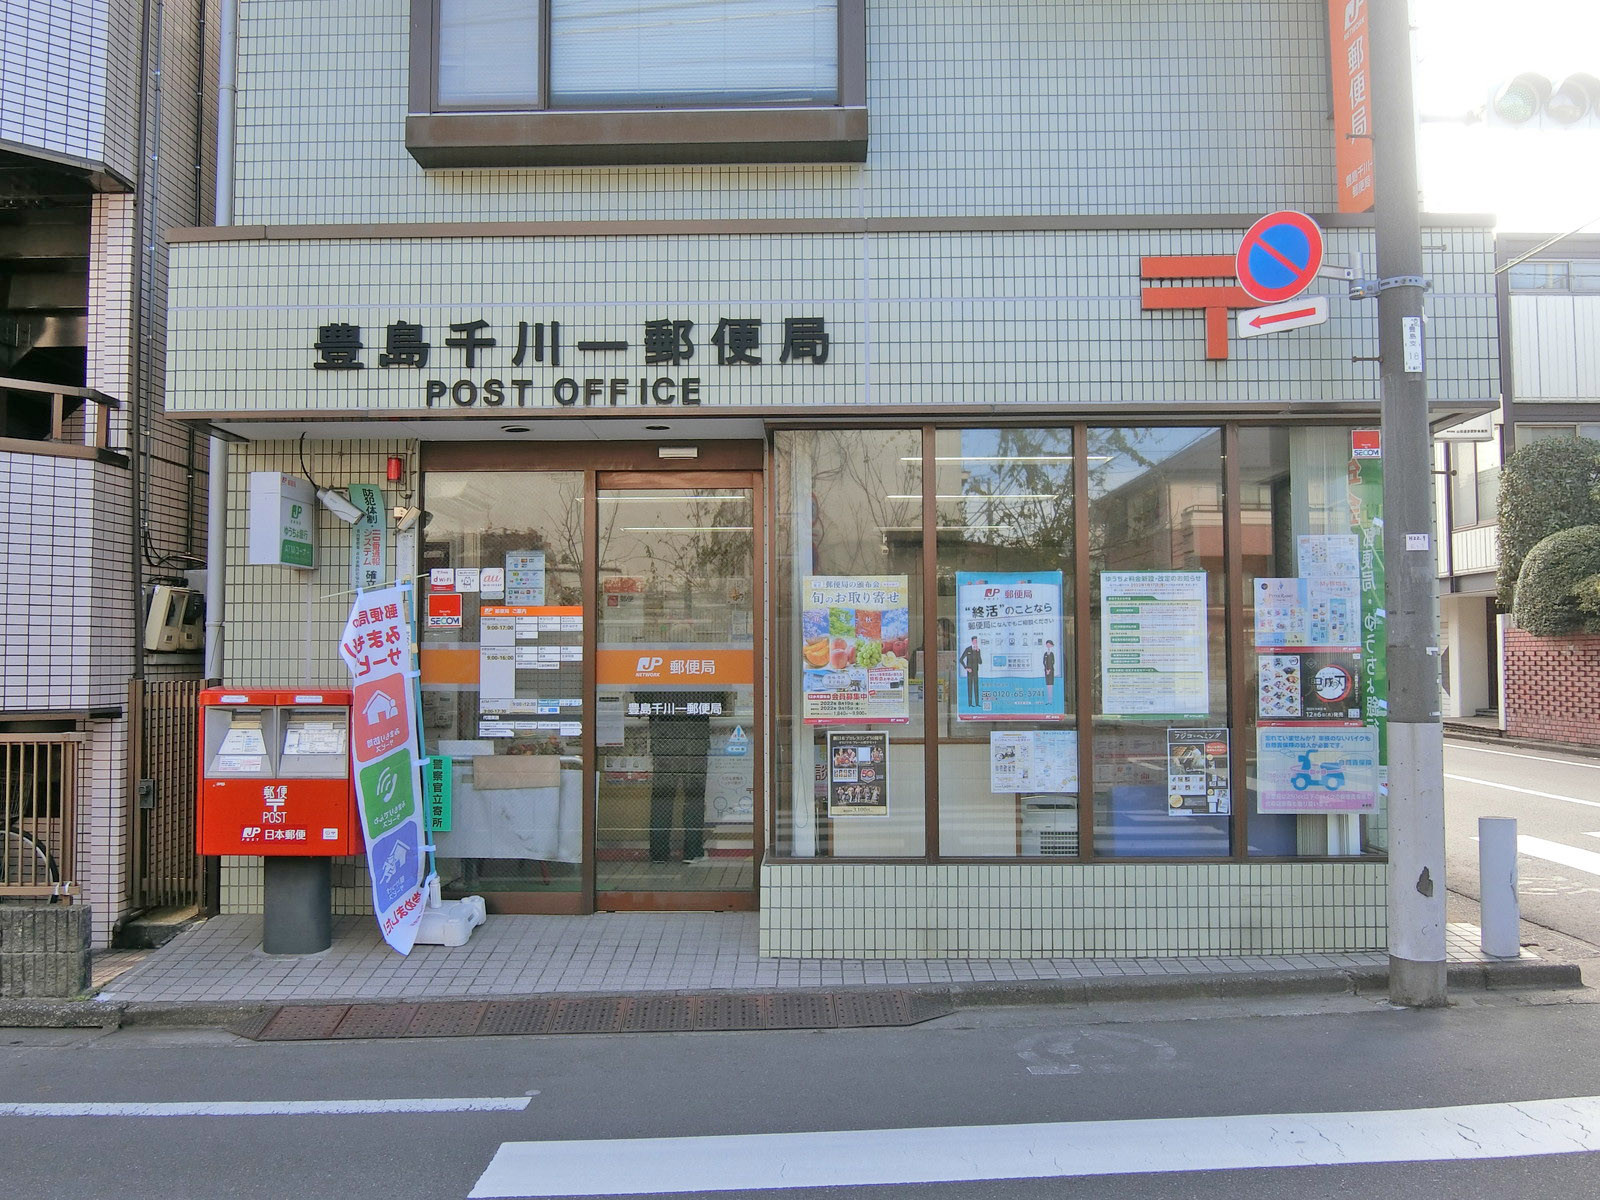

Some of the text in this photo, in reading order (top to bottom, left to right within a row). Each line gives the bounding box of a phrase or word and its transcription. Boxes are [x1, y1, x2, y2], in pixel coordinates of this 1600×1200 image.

[1347, 35, 1367, 145] 郵便局
[314, 317, 831, 370] 豊島千川一郵便局
[426, 376, 702, 408] POST OFFICE
[284, 527, 309, 541] ゆうちょ銀行
[363, 528, 373, 566] システム
[483, 574, 502, 583] au
[825, 580, 881, 589] 郵便局の頒布会
[811, 591, 900, 605] 旬のお取り寄せ
[1005, 590, 1033, 599] 郵便局
[430, 616, 460, 625] SECOM
[968, 617, 1055, 631] 郵便局になんでもご相談ください
[636, 656, 664, 672] JP
[669, 659, 716, 675] 郵便局
[627, 702, 723, 715] 豊島千川一郵便局
[1174, 732, 1222, 740] フジコ・ヘミング
[263, 785, 288, 800] 郵便
[432, 758, 443, 828] 警察官立寄所
[262, 811, 288, 824] POST
[242, 827, 261, 838] JP
[264, 829, 307, 841] 日本郵便
